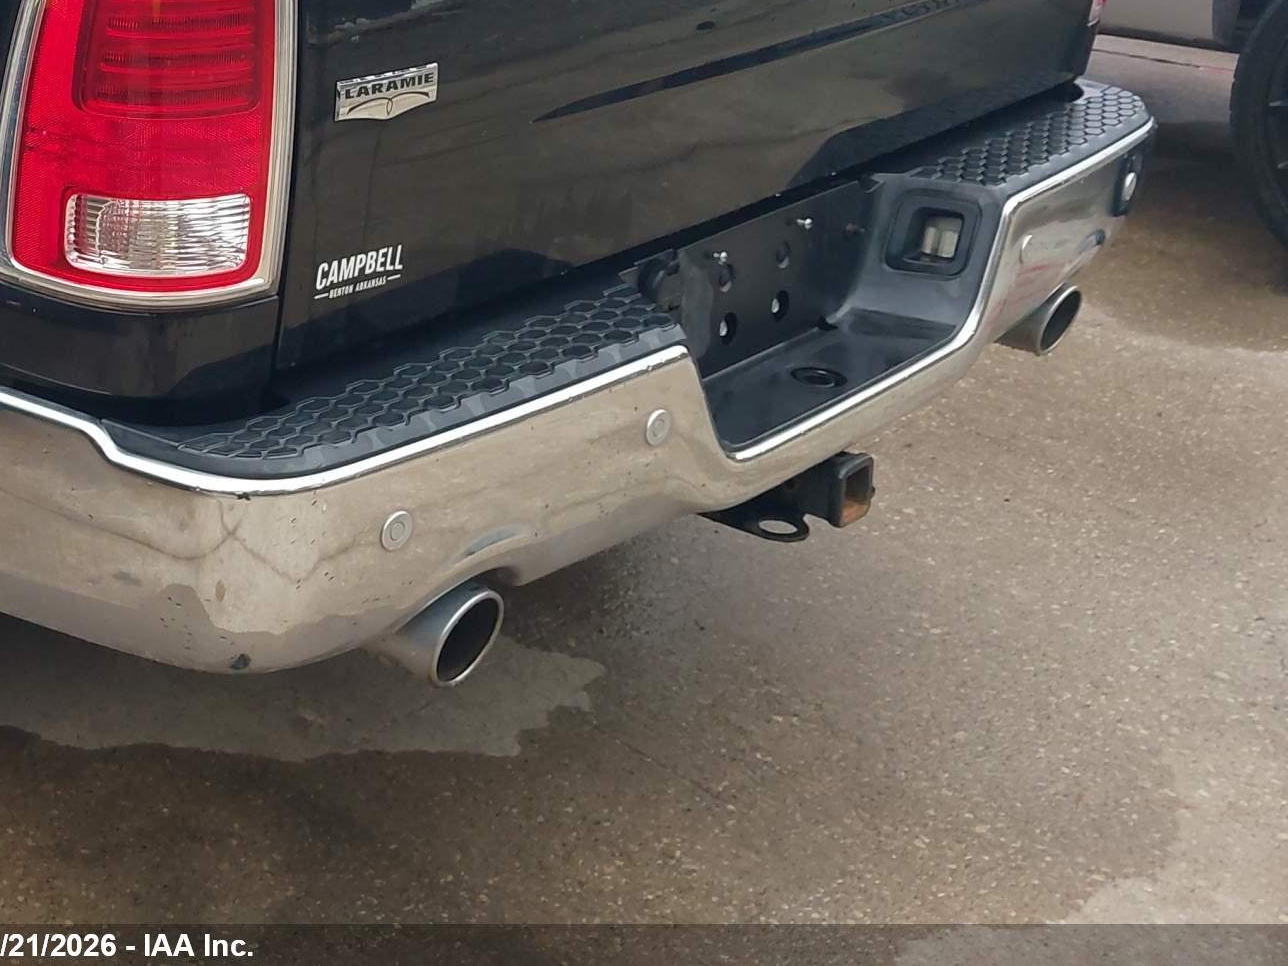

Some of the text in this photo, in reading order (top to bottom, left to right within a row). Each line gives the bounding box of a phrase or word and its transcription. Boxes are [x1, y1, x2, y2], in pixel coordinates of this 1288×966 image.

[345, 72, 434, 99] LARAMIE
[315, 243, 403, 291] CAMPBELL
[328, 275, 387, 299] BENTON ARKANSAS
